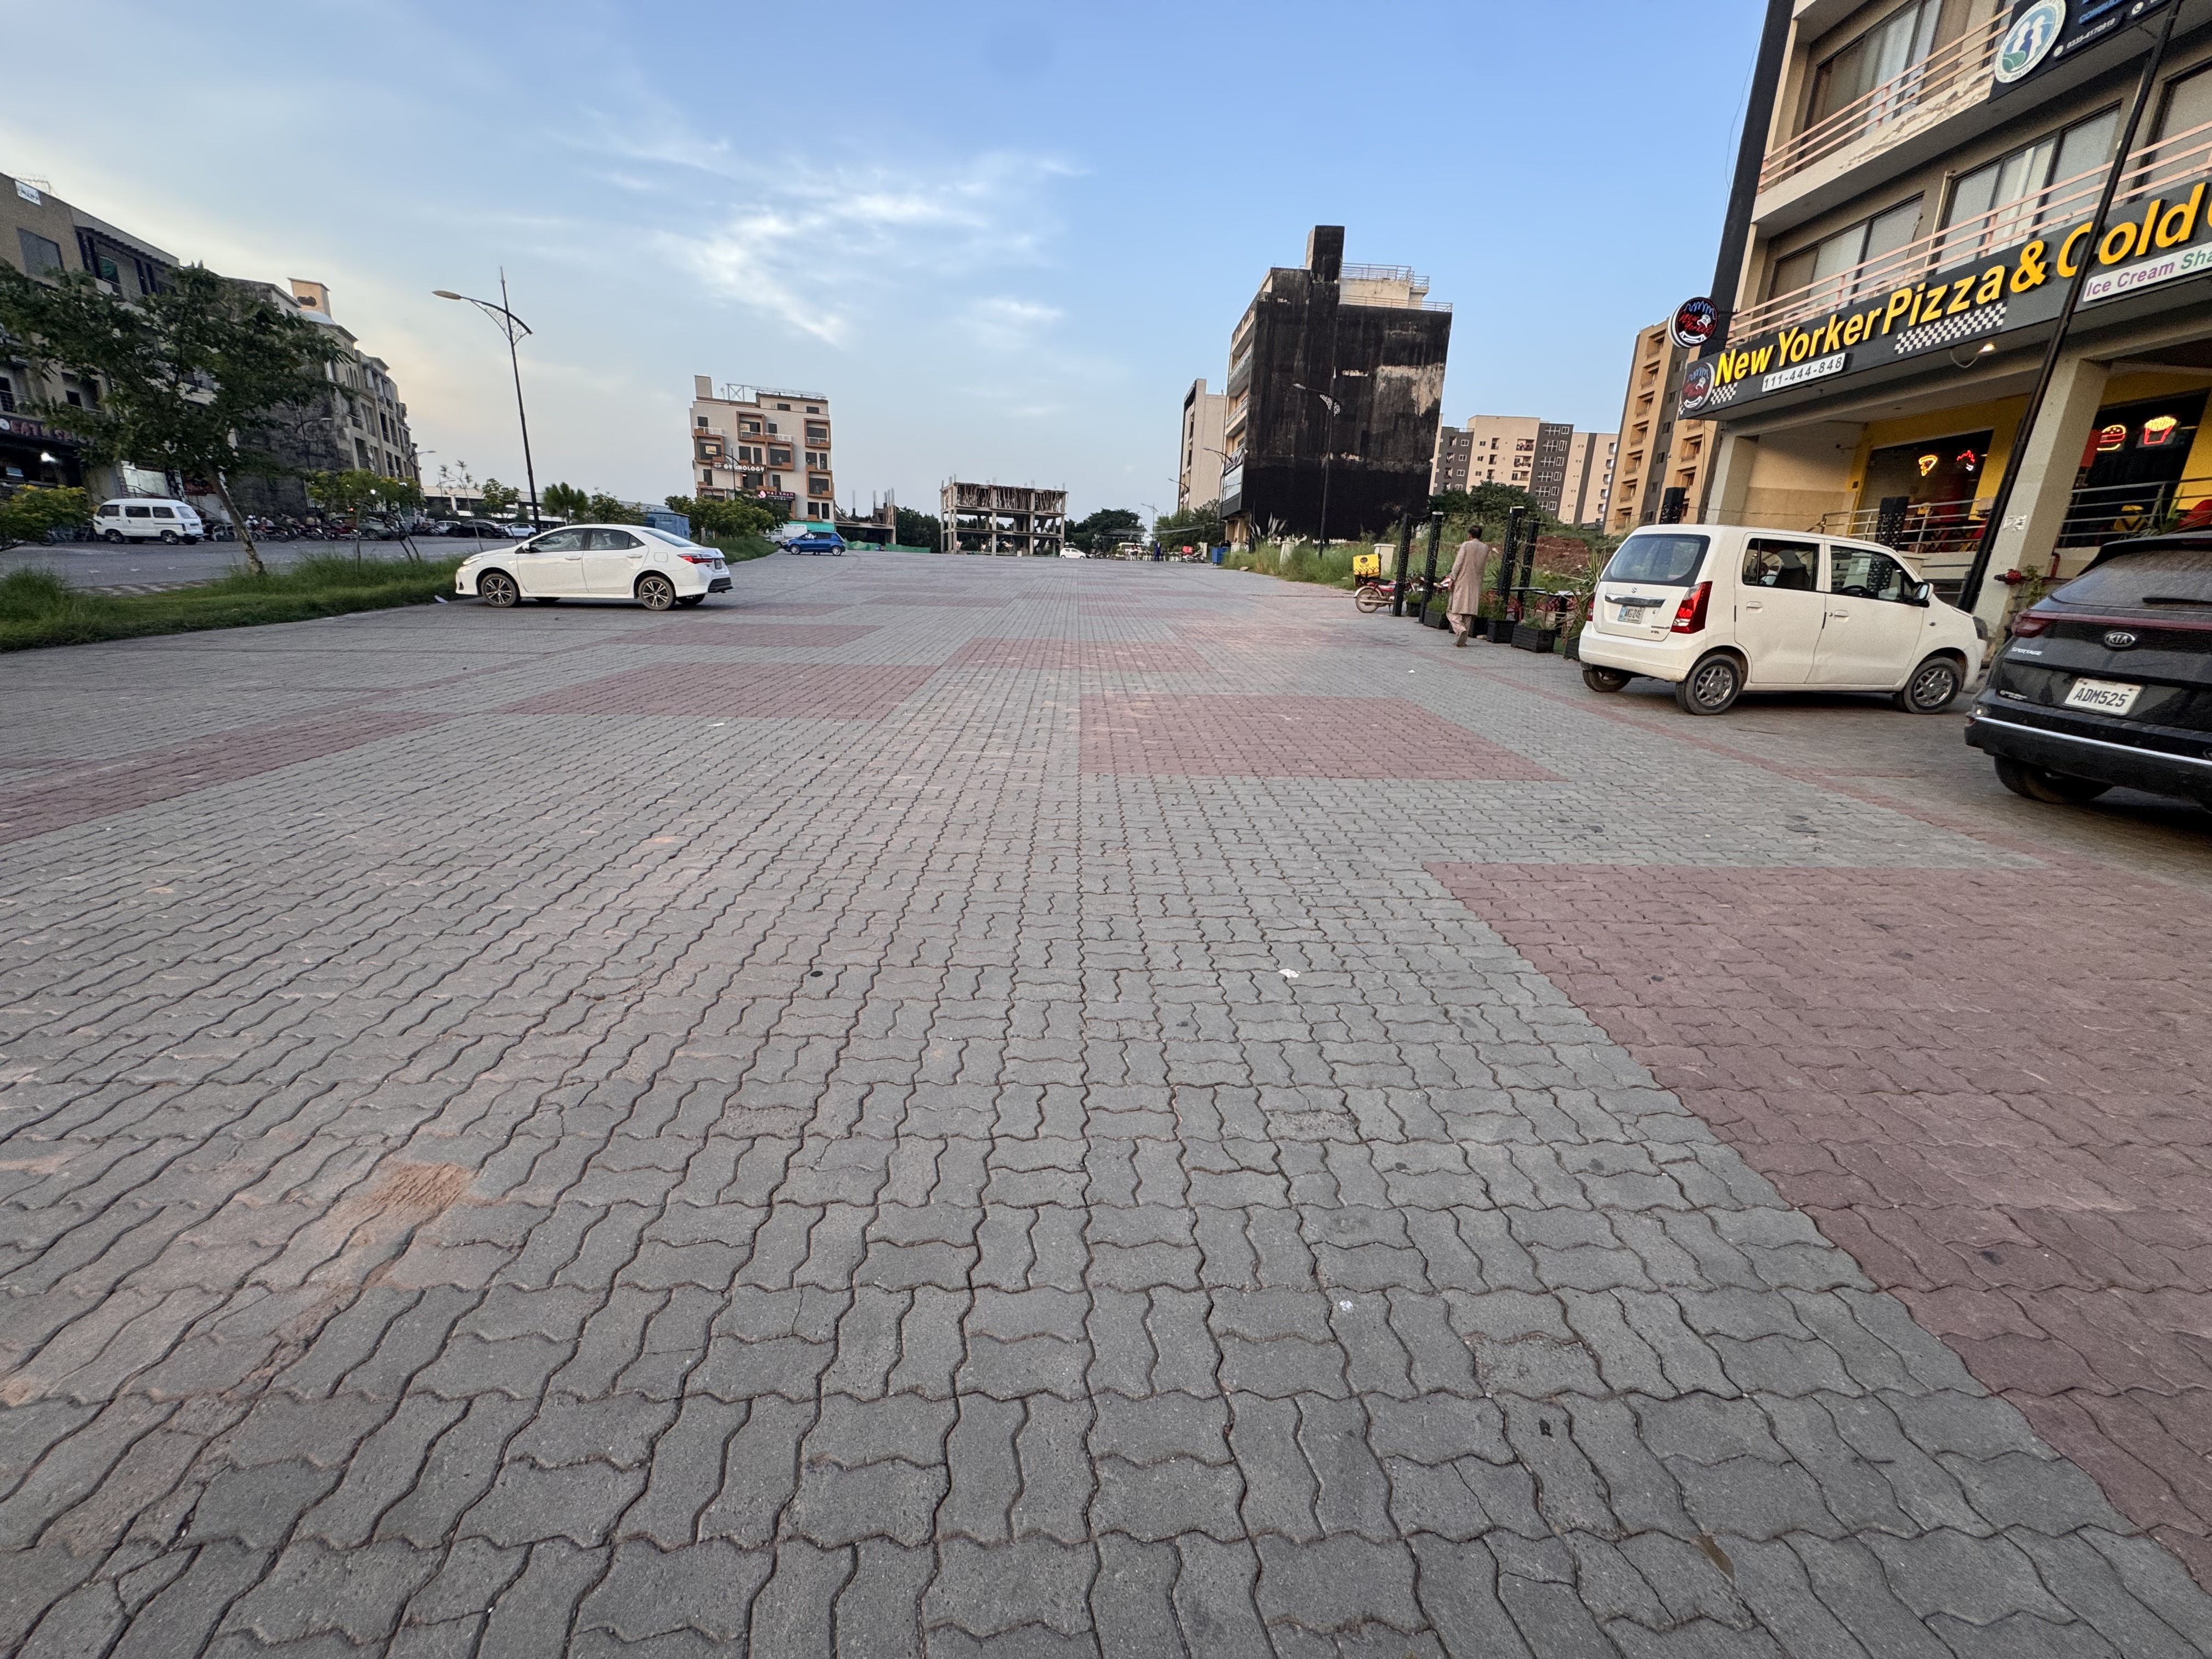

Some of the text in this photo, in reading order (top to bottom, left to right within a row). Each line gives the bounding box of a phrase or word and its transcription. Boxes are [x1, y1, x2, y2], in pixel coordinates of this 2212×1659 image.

[1715, 345, 1774, 387] New
[1779, 307, 1883, 366] Yorker
[1882, 265, 2005, 335] Pizza
[2010, 239, 2047, 293] &
[2057, 182, 2205, 278] Cold
[2086, 280, 2111, 297] Ice
[2117, 262, 2175, 287] Cream
[1764, 356, 1843, 389] 111-444-848
[2107, 634, 2128, 644] KIA
[2073, 687, 2129, 707] ADM525
